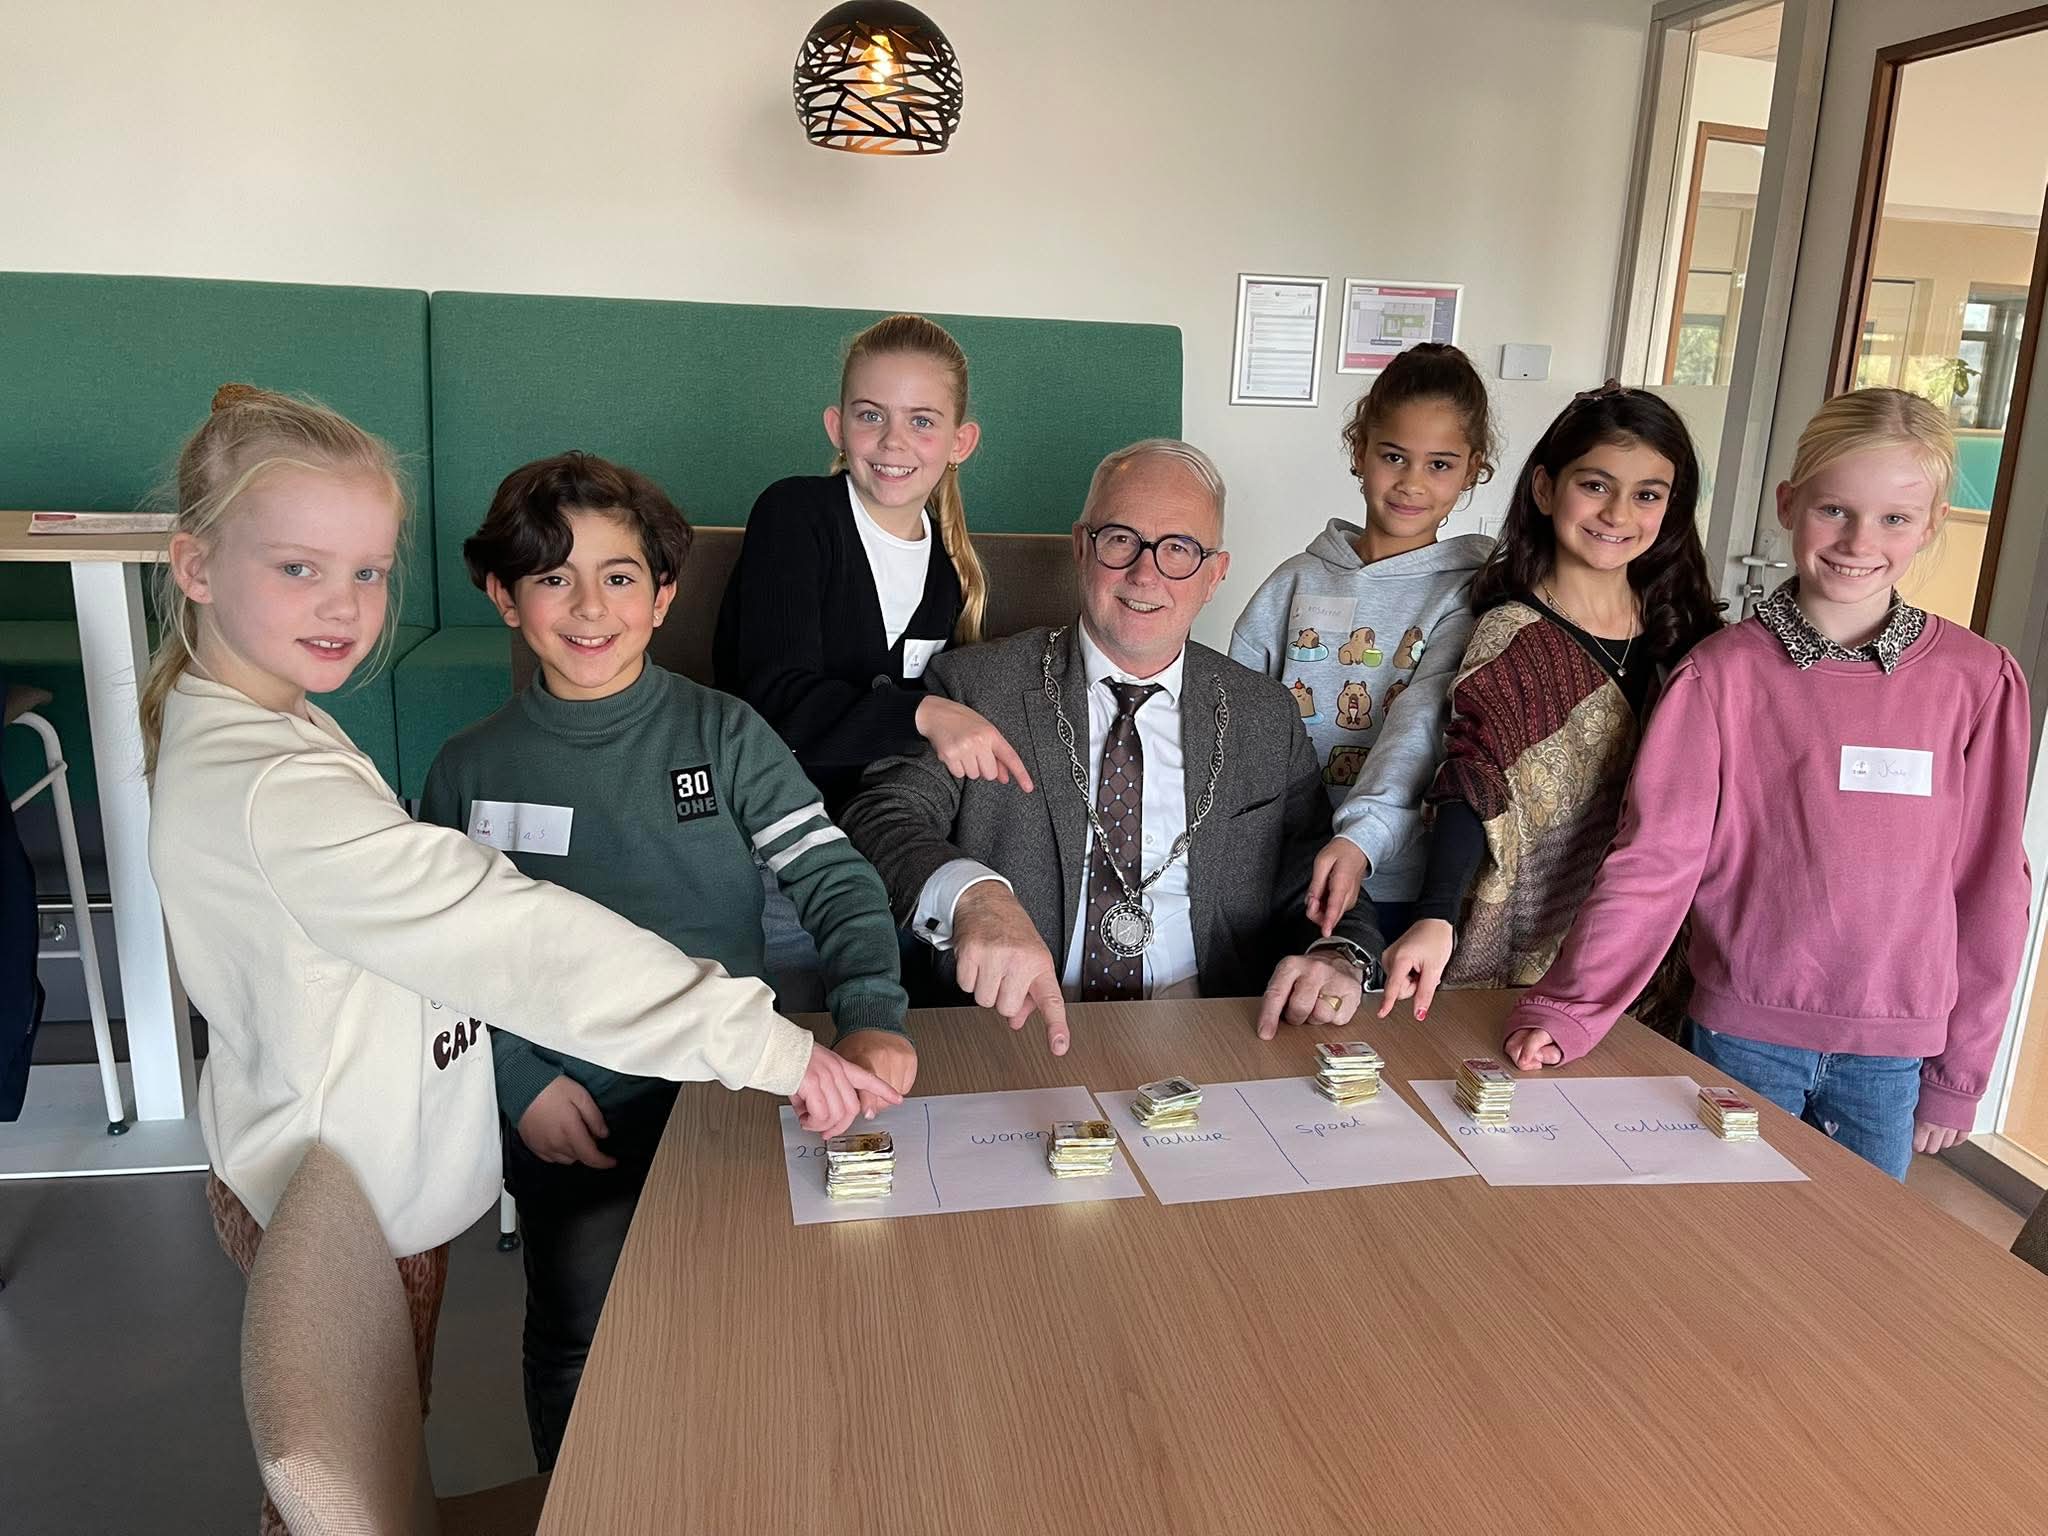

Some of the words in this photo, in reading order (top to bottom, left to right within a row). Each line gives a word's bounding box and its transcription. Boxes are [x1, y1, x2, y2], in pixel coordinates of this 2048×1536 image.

[677, 770, 710, 798] 30
[677, 796, 717, 816] ONE
[971, 1130, 1050, 1145] wonen
